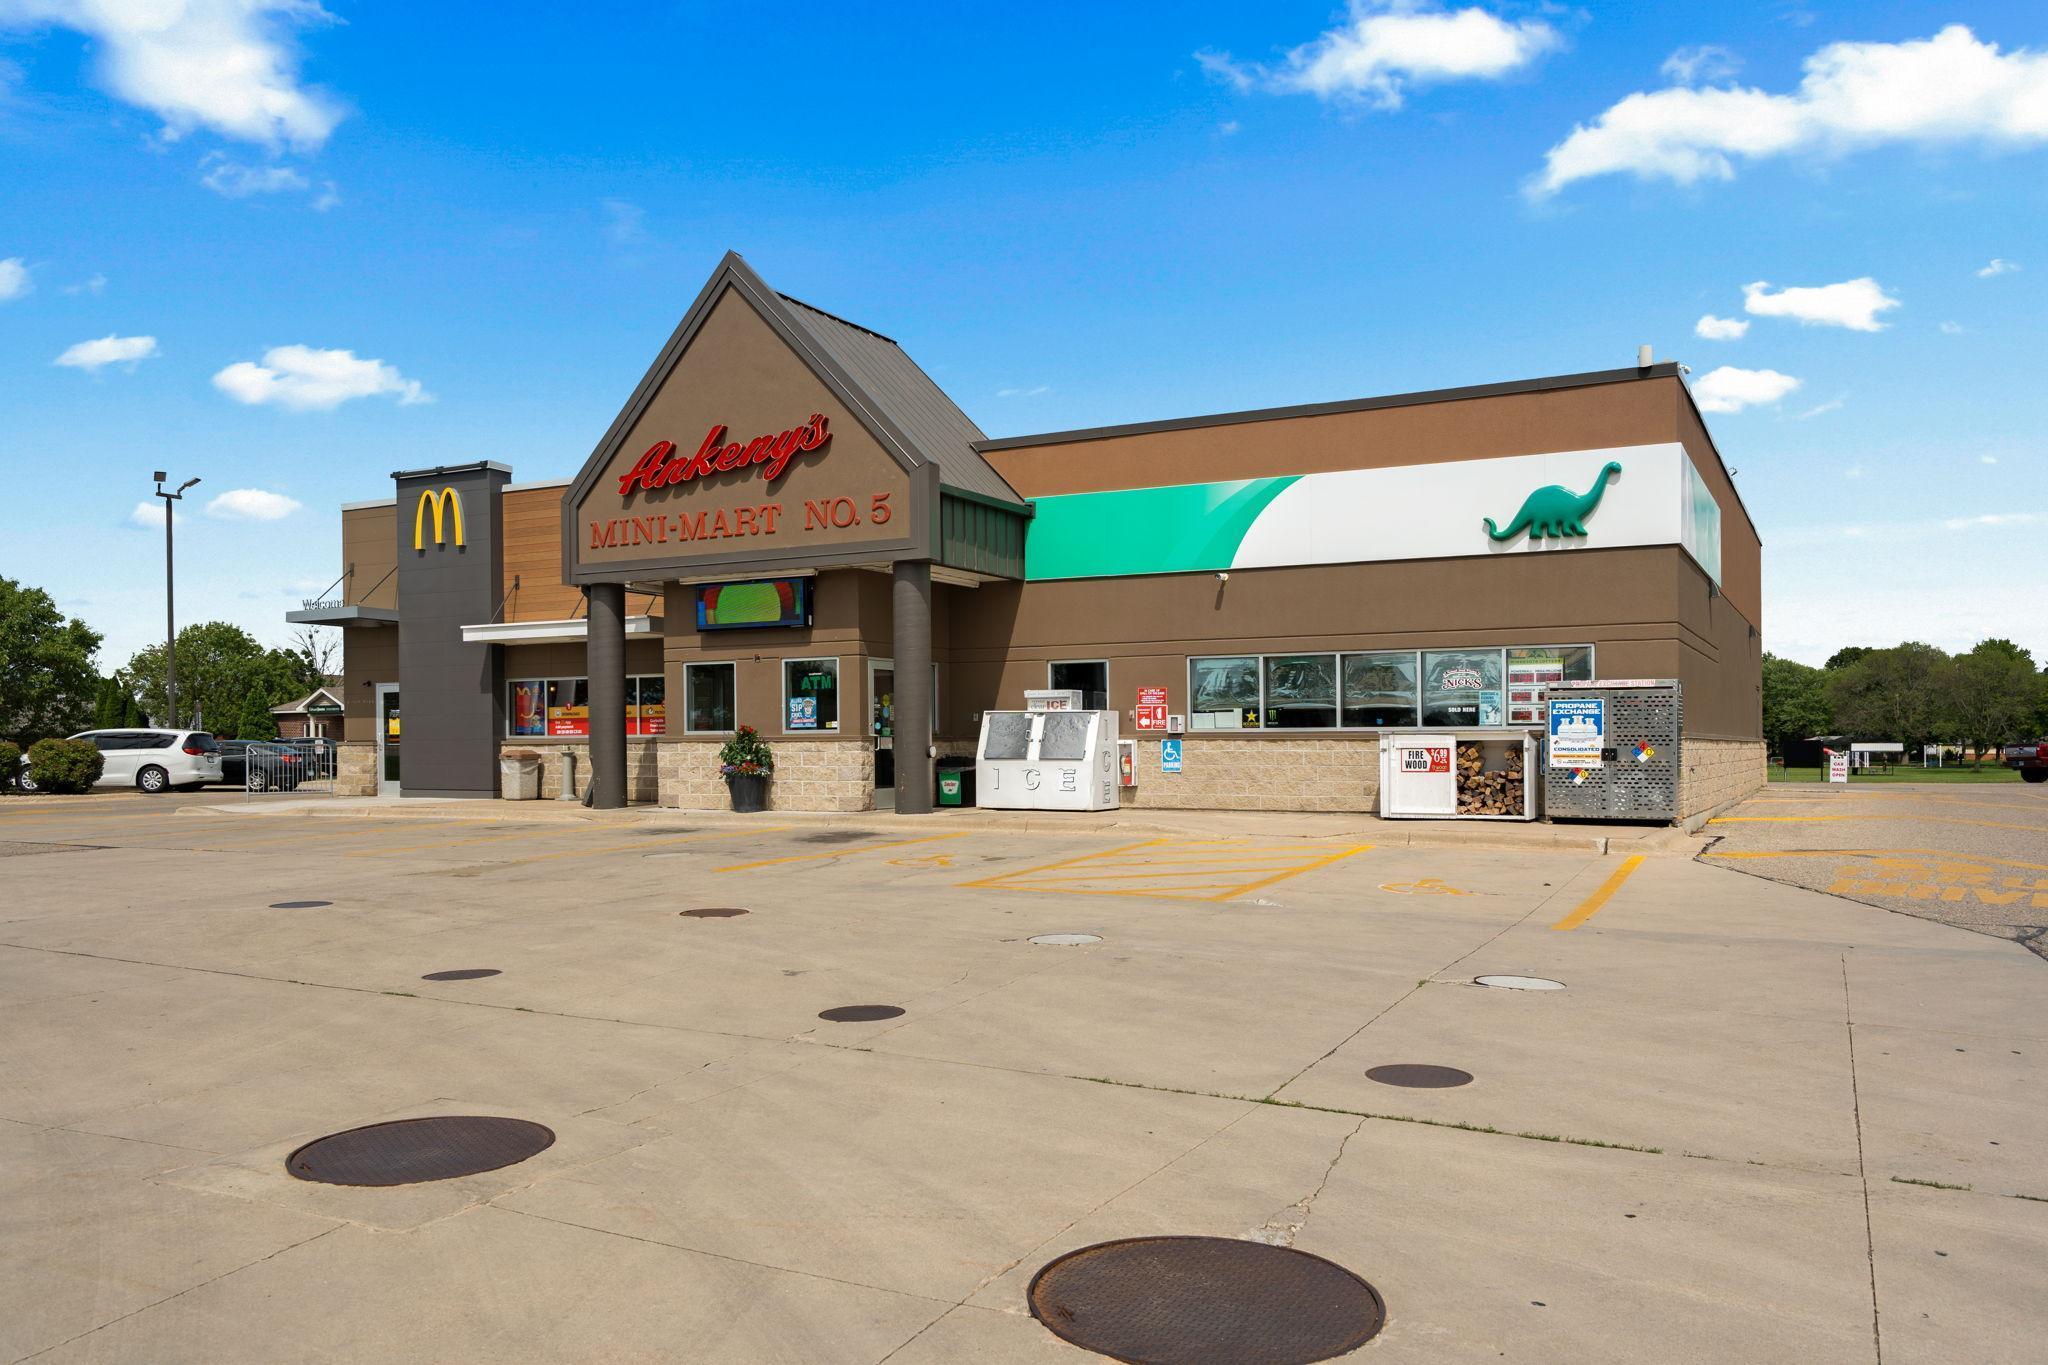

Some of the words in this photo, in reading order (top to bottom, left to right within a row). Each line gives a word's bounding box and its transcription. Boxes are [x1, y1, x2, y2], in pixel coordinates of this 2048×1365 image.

[617, 411, 833, 496] Ankeny's
[590, 503, 783, 549] MINI-MART
[804, 495, 862, 531] NO.
[871, 492, 892, 525] 5
[801, 674, 832, 690] ATM
[791, 703, 803, 712] SIP
[1046, 700, 1068, 710] ICE
[1408, 750, 1424, 760] FIRE
[1404, 760, 1428, 769] WOOD
[992, 766, 1077, 793] ICE
